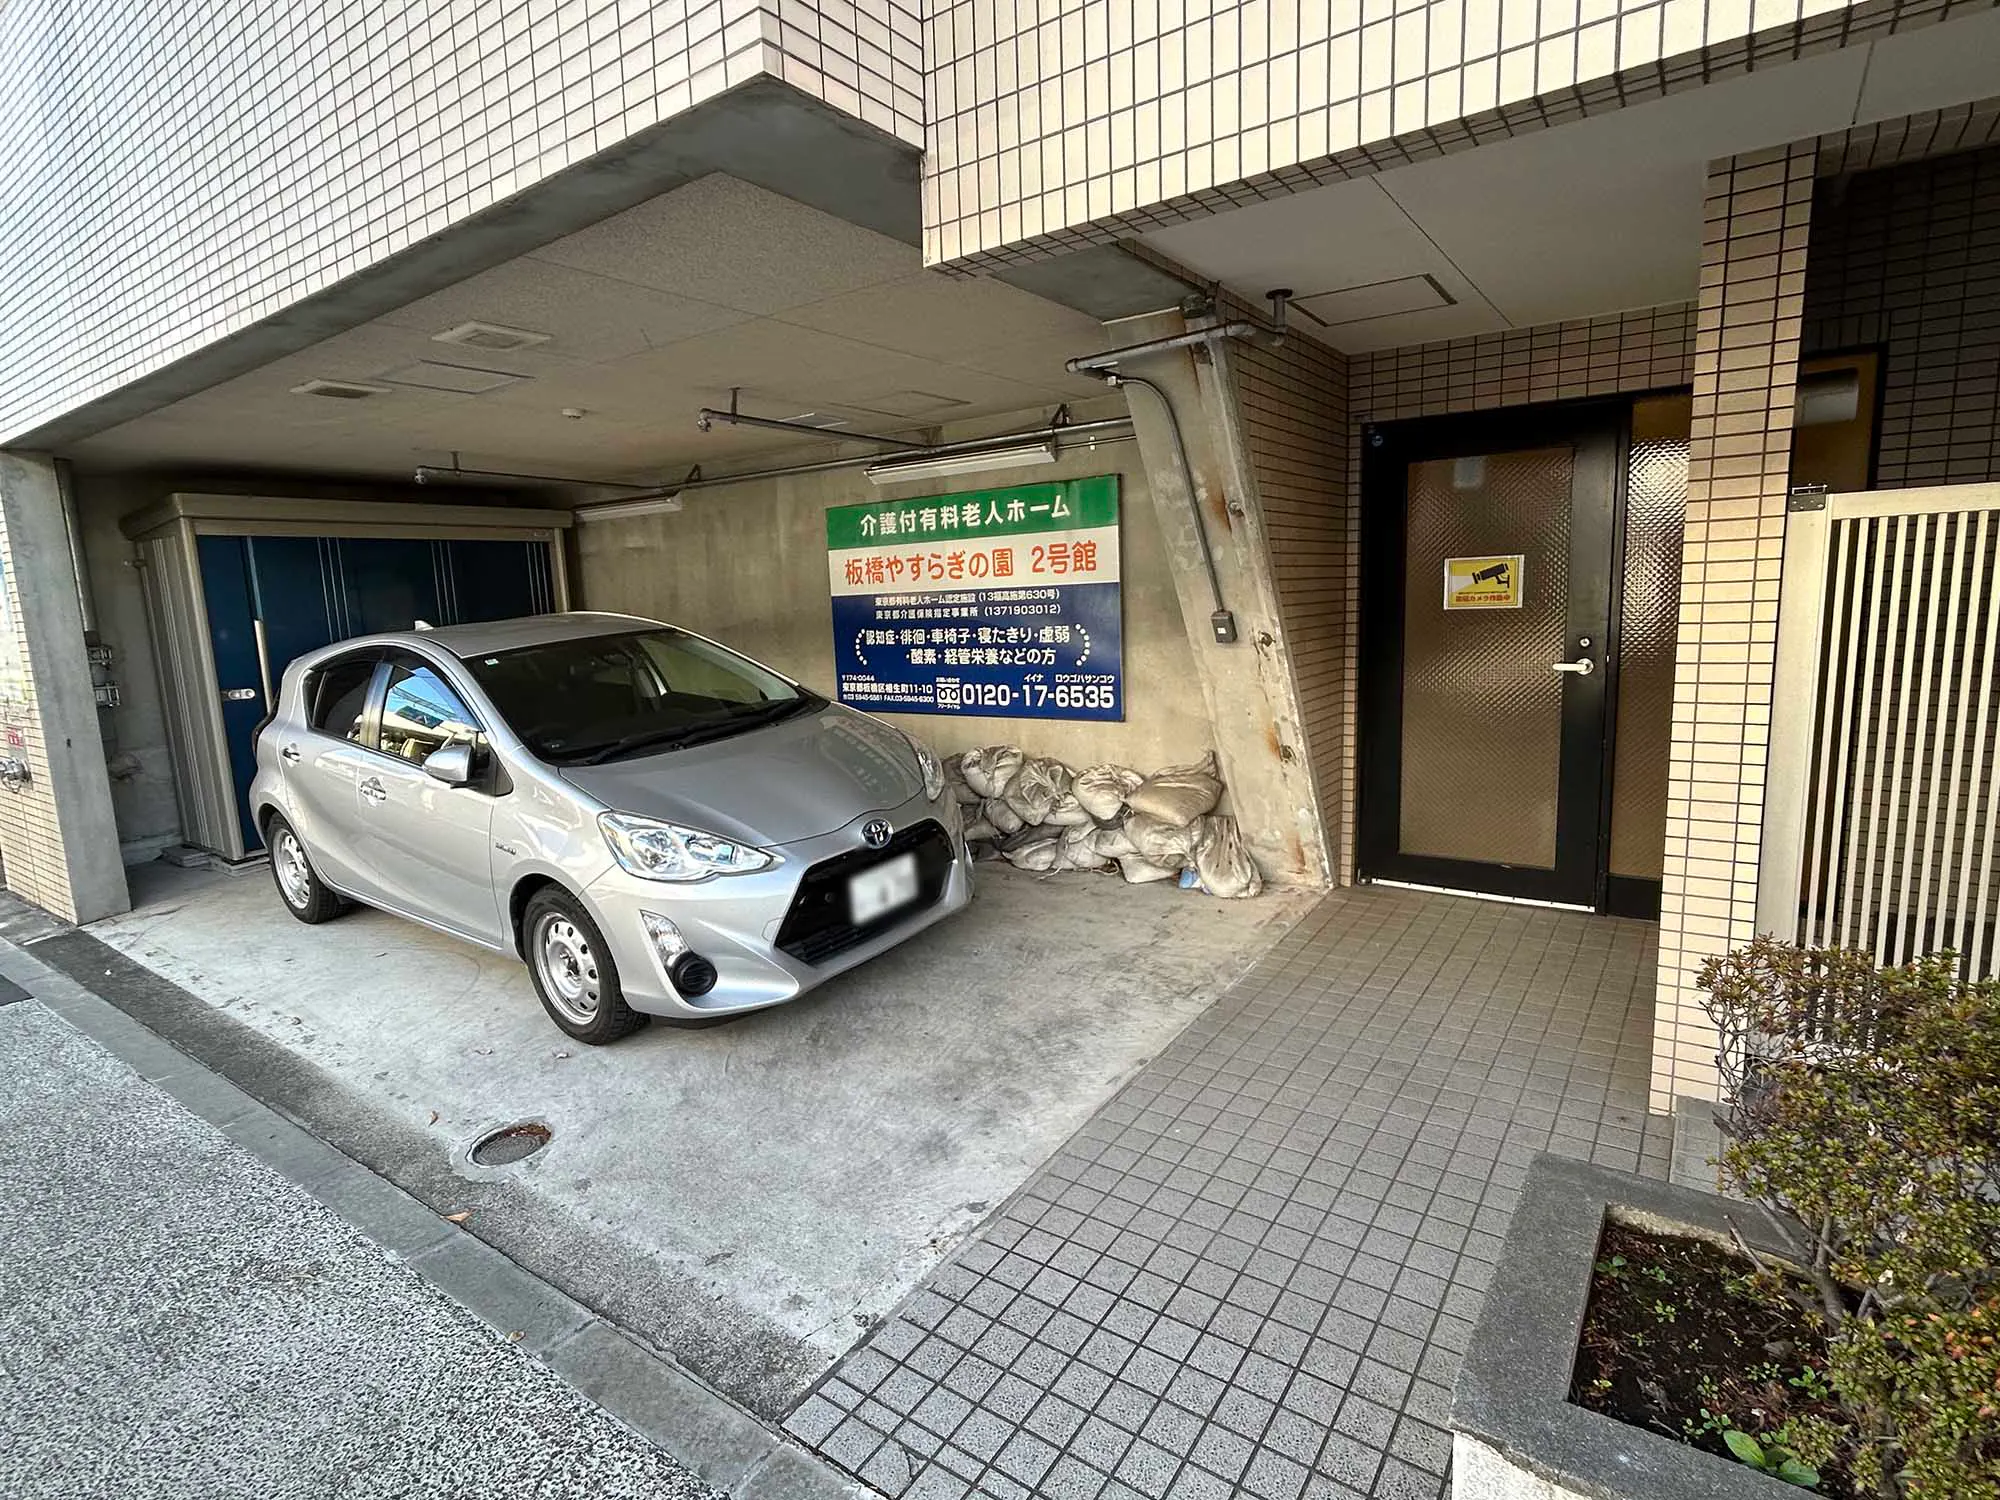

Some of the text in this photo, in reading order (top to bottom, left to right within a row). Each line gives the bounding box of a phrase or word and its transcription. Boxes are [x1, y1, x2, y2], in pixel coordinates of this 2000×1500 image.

[860, 496, 1070, 537] 介護付有料老人ホーム
[844, 540, 1098, 586] 板橋やすらぎの園 2号館
[984, 604, 1061, 616] (1371903012)
[1024, 673, 1115, 684] イイナ ロウゴハサンコウ
[962, 683, 1115, 709] 0120-17-6535
